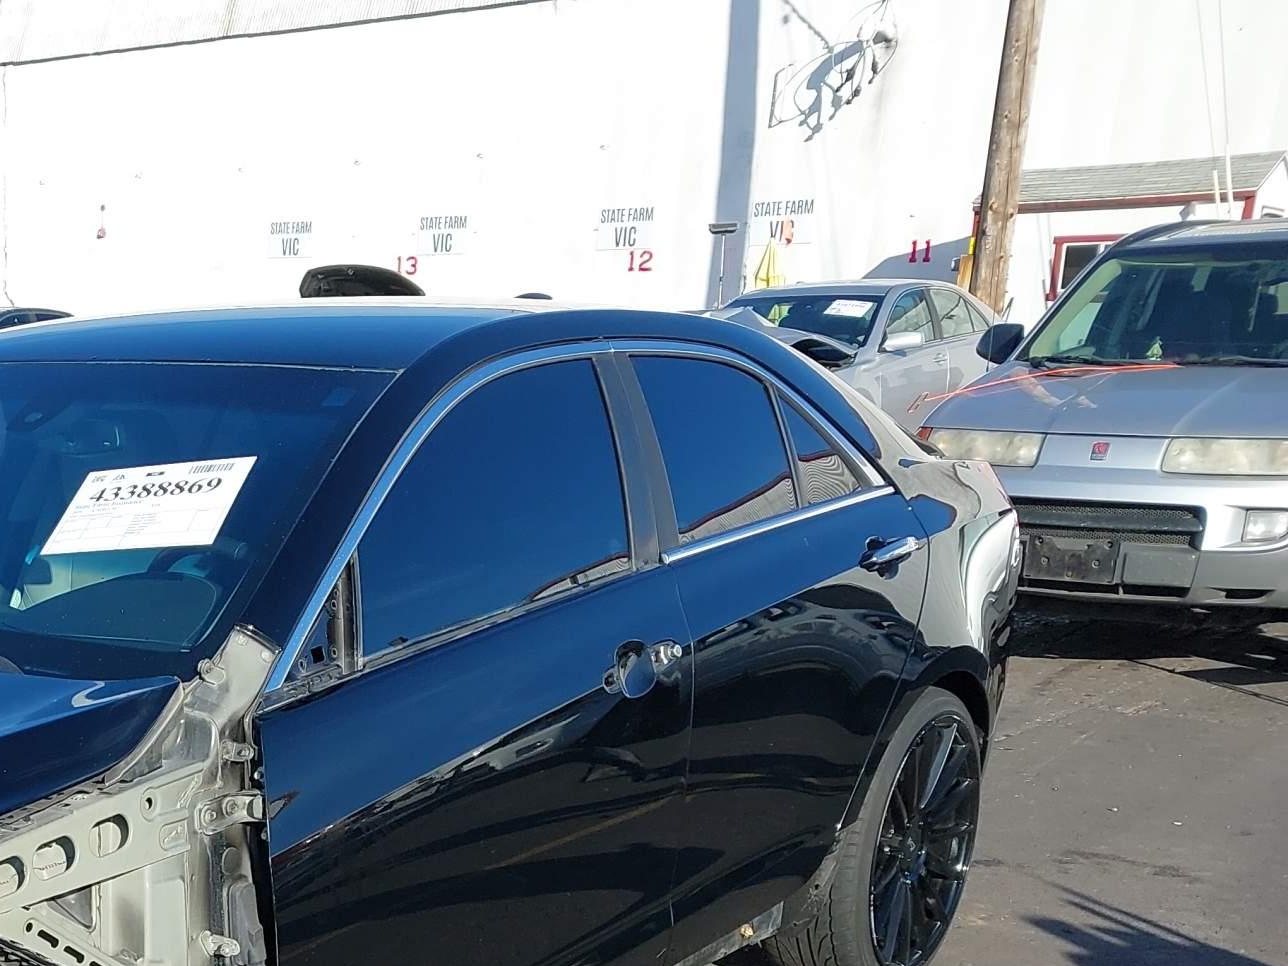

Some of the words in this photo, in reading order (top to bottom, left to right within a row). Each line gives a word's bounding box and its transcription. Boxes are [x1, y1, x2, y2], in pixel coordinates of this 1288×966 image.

[601, 208, 626, 223] STATE
[627, 207, 654, 222] FARM
[754, 202, 783, 217] STATE
[784, 200, 814, 215] FARM
[270, 222, 290, 235] STATE
[291, 221, 312, 234] FARM
[420, 217, 443, 230] STATE
[444, 216, 467, 229] FARM
[432, 233, 452, 252] VIC
[614, 226, 637, 247] VIC
[282, 238, 299, 256] VIC
[909, 239, 931, 263] 11
[396, 255, 418, 275] 13
[628, 250, 653, 272] 12
[89, 477, 223, 502] 43388869
